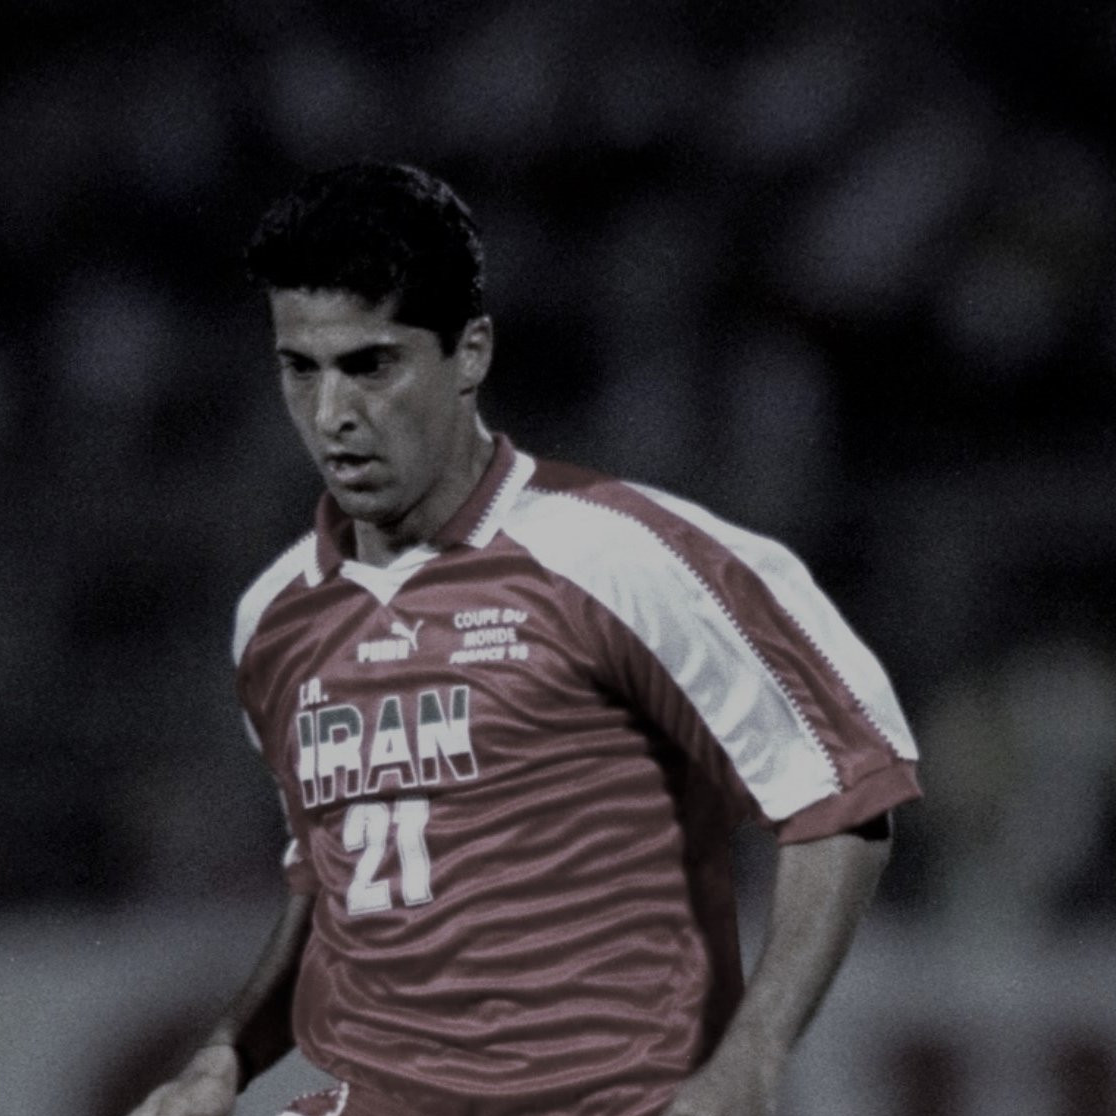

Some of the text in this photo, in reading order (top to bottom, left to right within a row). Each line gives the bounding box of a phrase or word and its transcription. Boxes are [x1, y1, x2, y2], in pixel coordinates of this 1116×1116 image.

[454, 608, 499, 629] COUPE
[464, 627, 517, 648] MONDE
[297, 685, 478, 809] IRAN
[343, 798, 434, 916] 21
